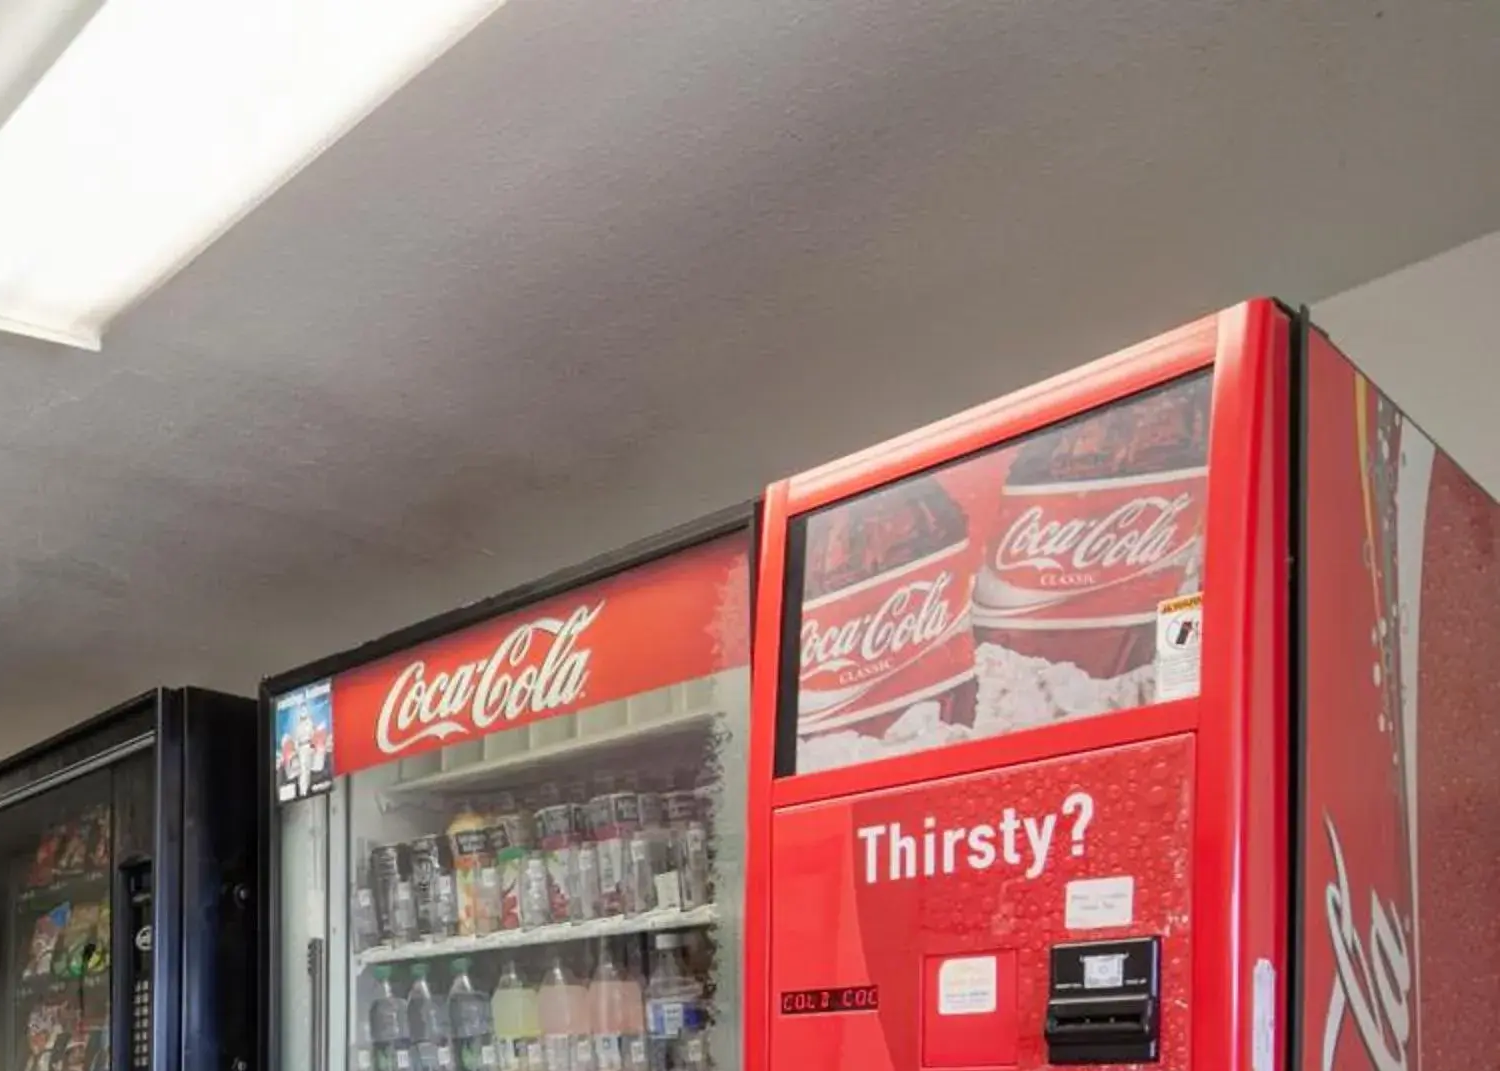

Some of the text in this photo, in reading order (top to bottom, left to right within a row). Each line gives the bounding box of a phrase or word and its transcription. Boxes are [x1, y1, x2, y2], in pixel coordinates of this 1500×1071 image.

[995, 491, 1192, 571] Coca-Cola
[1039, 571, 1097, 586] CLASSIC
[376, 602, 603, 754] Coca-Cola
[838, 659, 894, 686] CLASSIC
[857, 792, 1094, 884] Thirsty?
